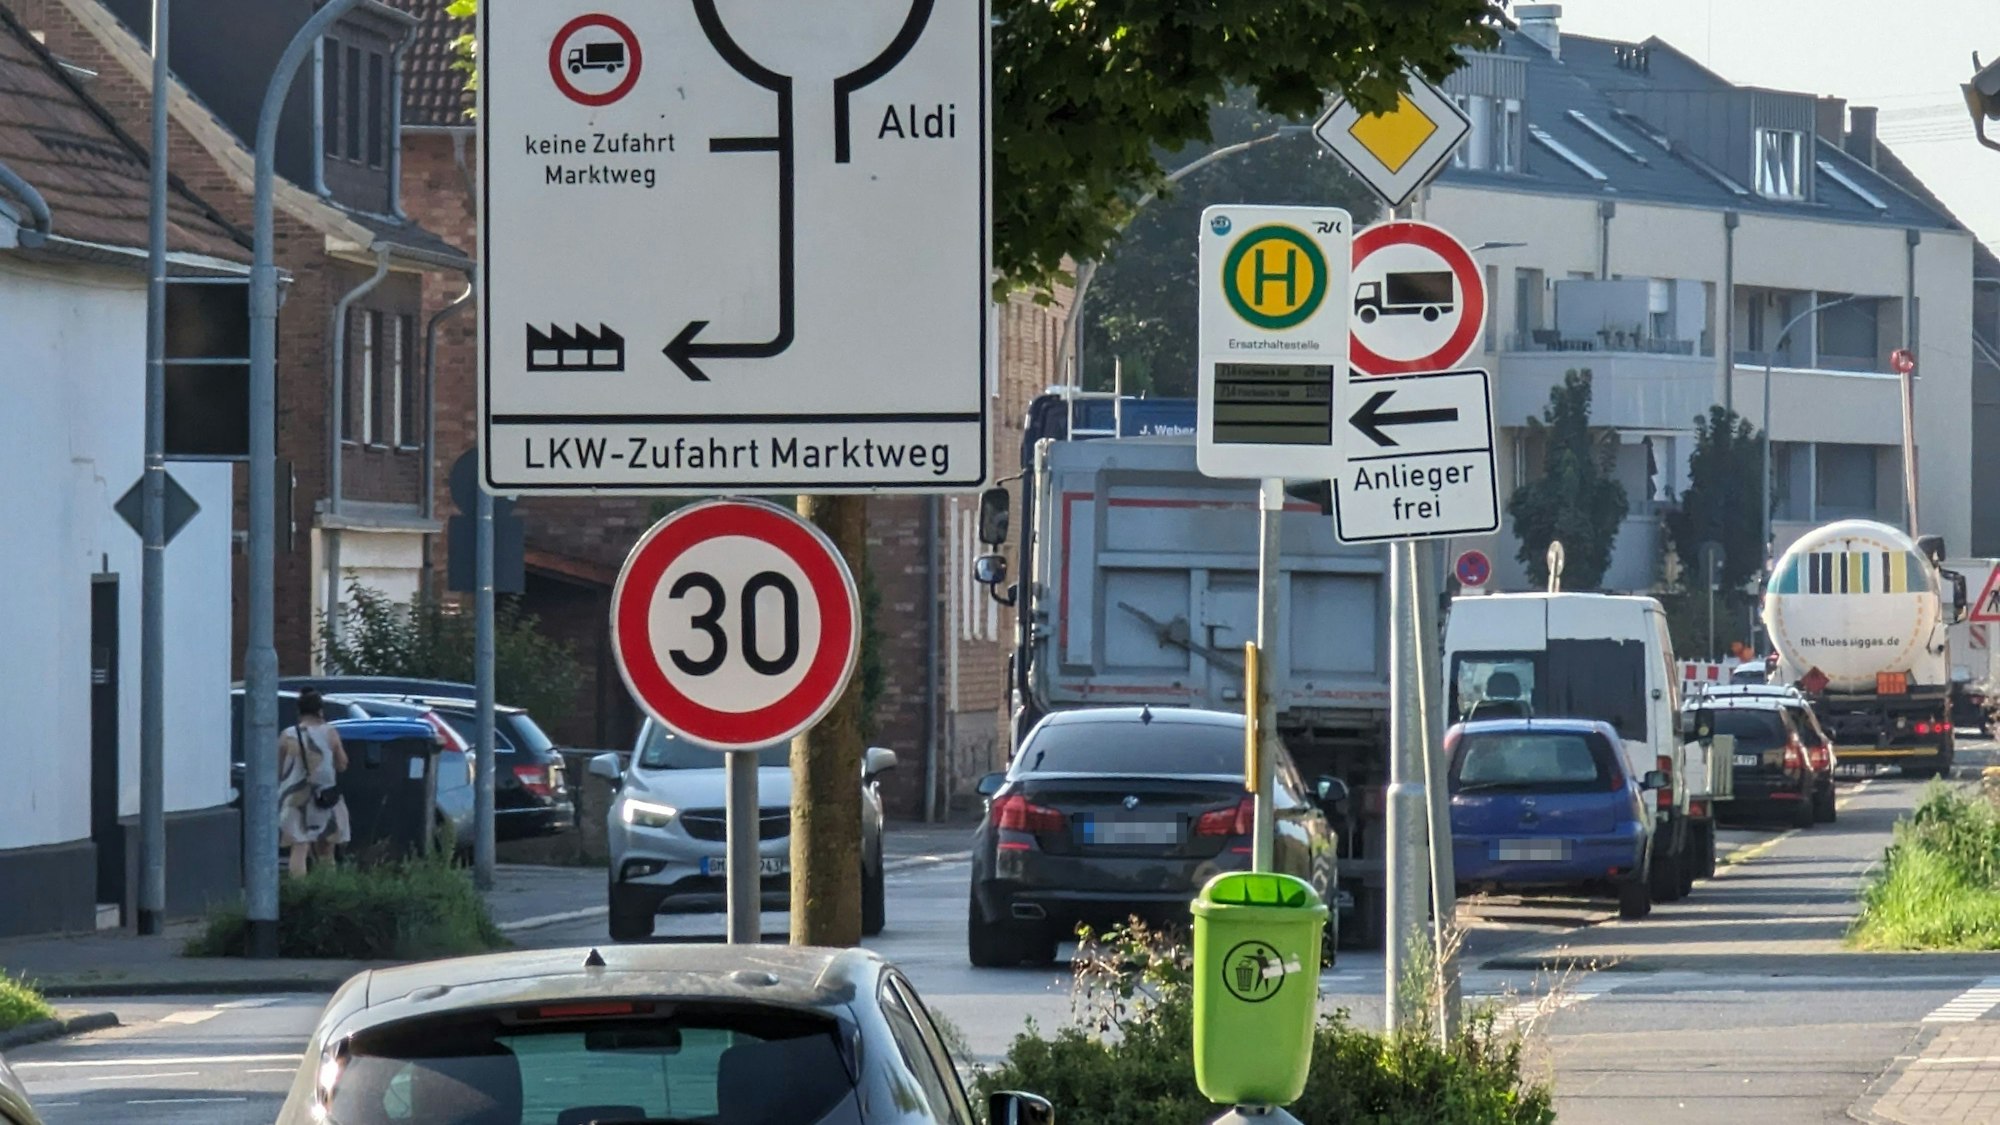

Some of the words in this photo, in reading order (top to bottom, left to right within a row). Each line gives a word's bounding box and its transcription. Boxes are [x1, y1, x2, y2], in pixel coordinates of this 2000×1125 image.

[878, 104, 956, 139] Aldi
[525, 134, 587, 155] keine
[592, 133, 676, 154] Zufahrt
[545, 165, 656, 188] Marktweg
[1254, 248, 1297, 307] H
[1228, 338, 1320, 350] Ersatzhaltestelle
[1139, 424, 1151, 435] J.
[1155, 424, 1196, 436] Weber
[525, 437, 759, 469] LKW-Zufahrt
[771, 437, 950, 475] Marktweg
[1354, 463, 1474, 493] Anlieger
[1393, 495, 1441, 520] frei
[669, 570, 800, 677] 30
